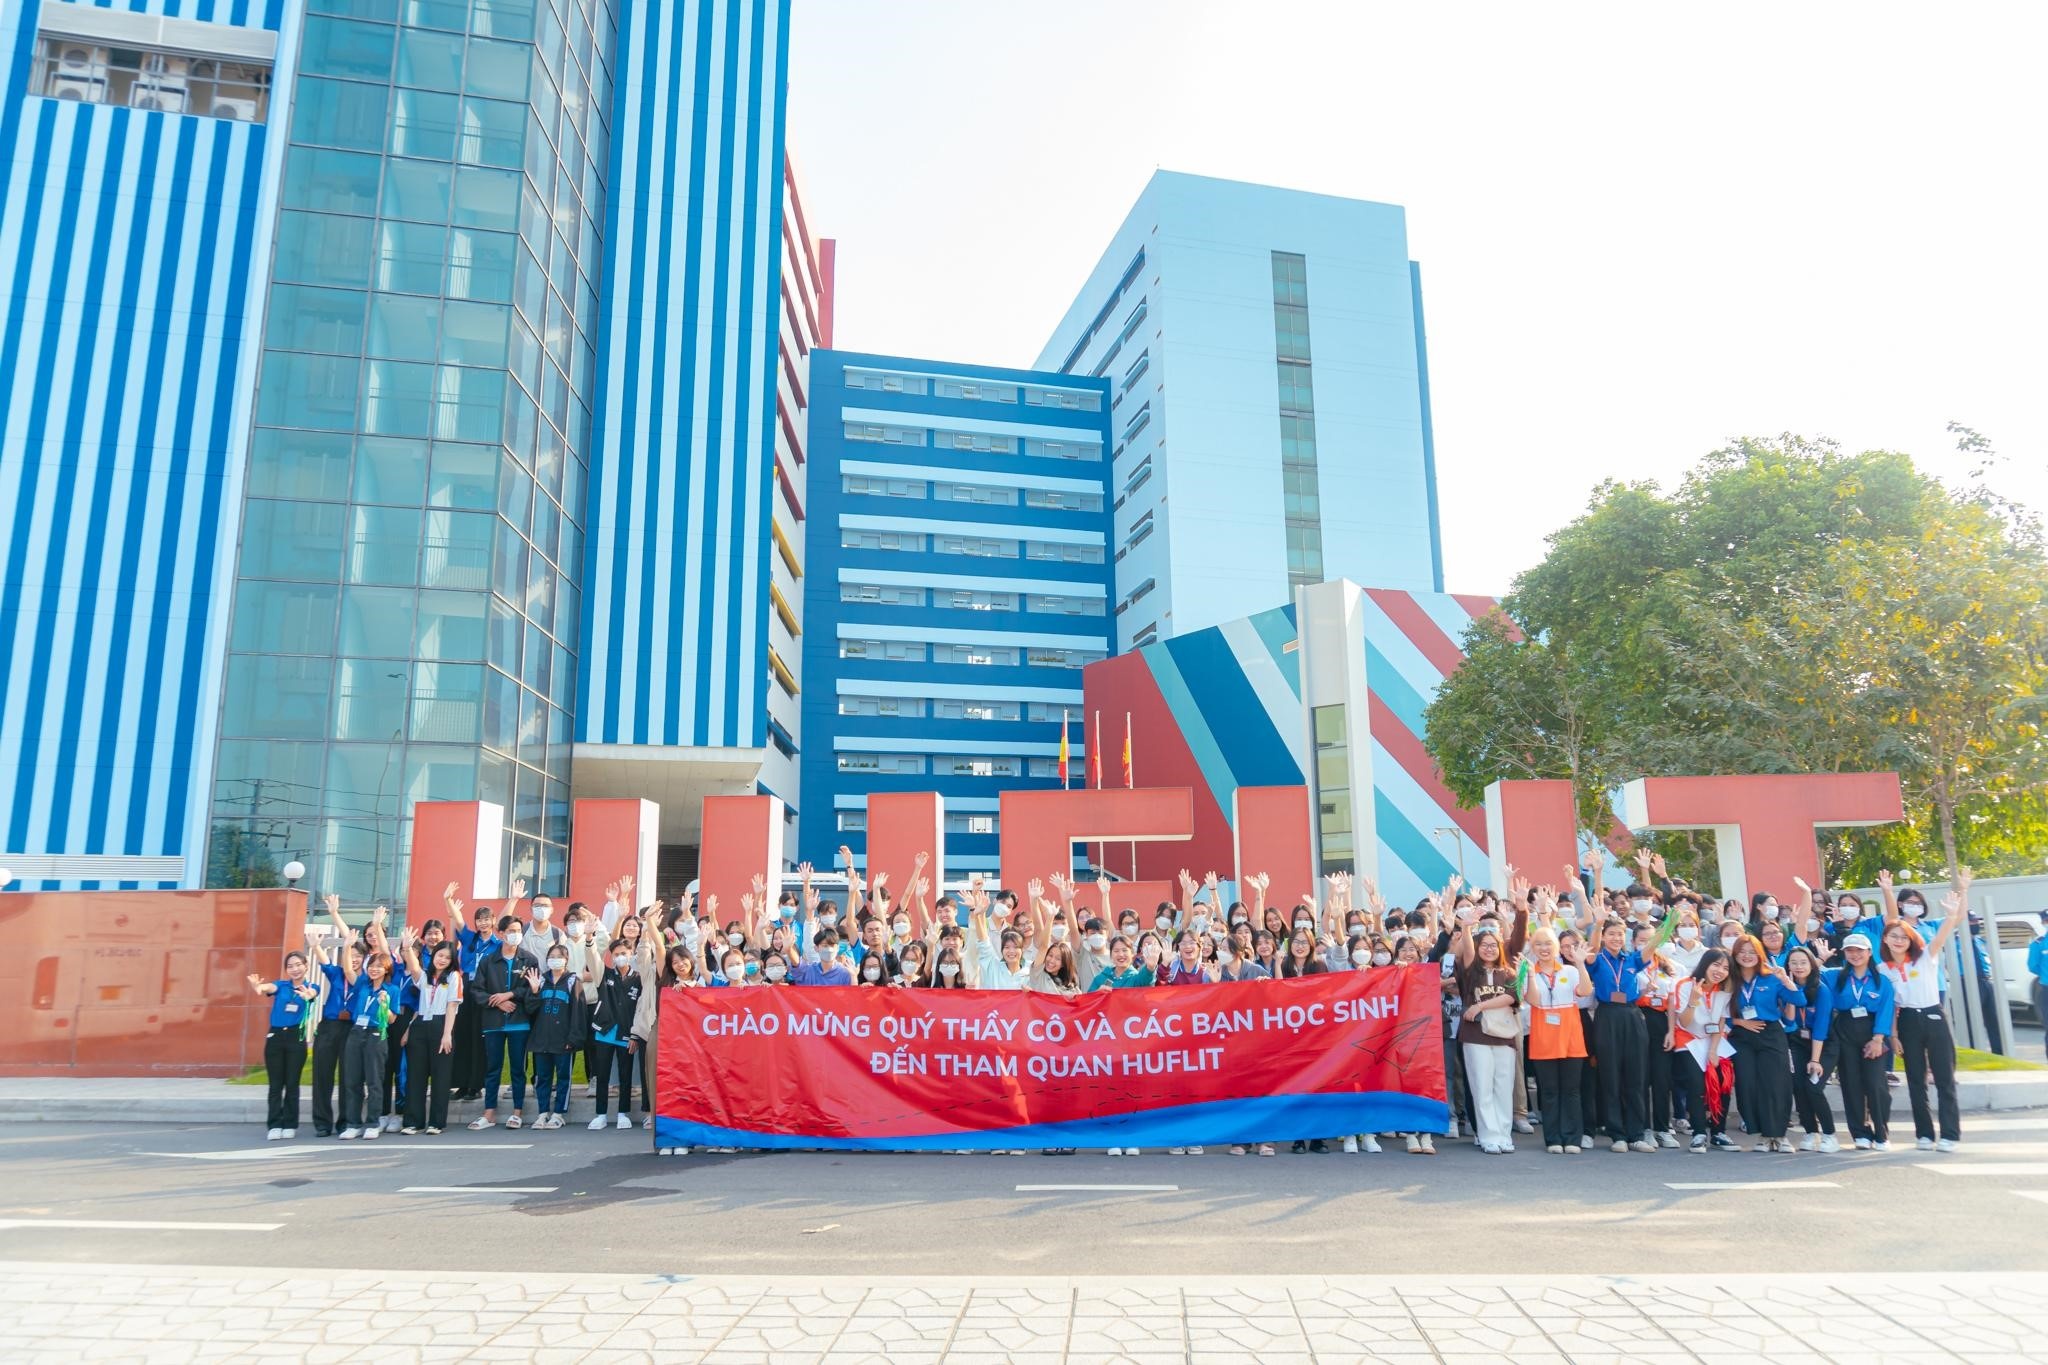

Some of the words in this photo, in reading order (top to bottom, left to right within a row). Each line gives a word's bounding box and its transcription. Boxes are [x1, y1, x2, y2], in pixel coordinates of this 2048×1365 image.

[404, 771, 1904, 942] HFIT
[702, 1007, 780, 1036] CHÀO
[787, 1008, 870, 1038] MỪNG
[879, 1011, 935, 1043] QUÝ
[942, 1010, 1019, 1041] THẦY
[1026, 1013, 1066, 1042] CÔ
[1074, 1011, 1116, 1041] VÀ
[1123, 1009, 1183, 1039] CÁC
[1191, 1009, 1253, 1039] BẠN
[1262, 1003, 1325, 1034] HỌC
[1332, 995, 1399, 1023] SINH
[869, 1044, 927, 1075] ĐẾN
[934, 1053, 1018, 1077] THAM
[1026, 1054, 1113, 1082] QUAN
[1122, 1048, 1225, 1075] HUFLIT
